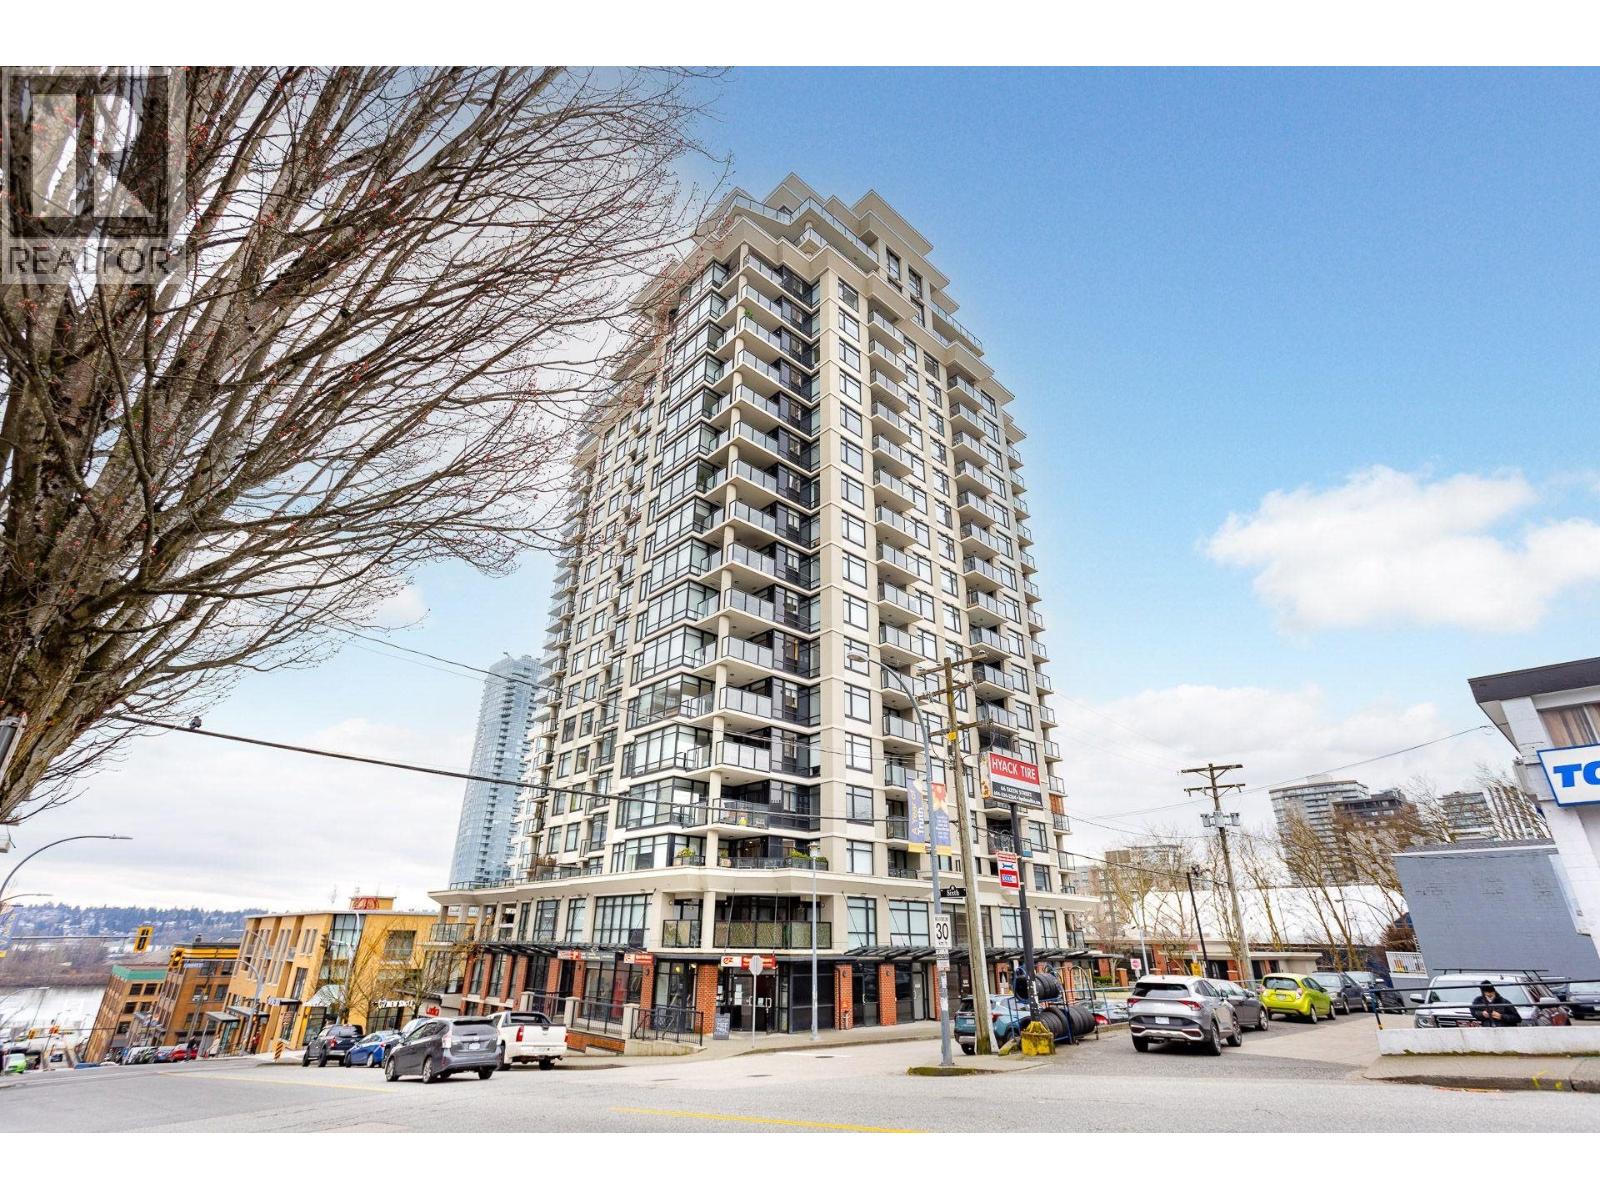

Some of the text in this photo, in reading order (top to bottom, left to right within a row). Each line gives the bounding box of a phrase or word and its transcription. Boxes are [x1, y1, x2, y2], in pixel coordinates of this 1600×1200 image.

[992, 758, 1036, 780] HYACK TIRE
[917, 807, 925, 836] Truth
[935, 922, 949, 940] 30
